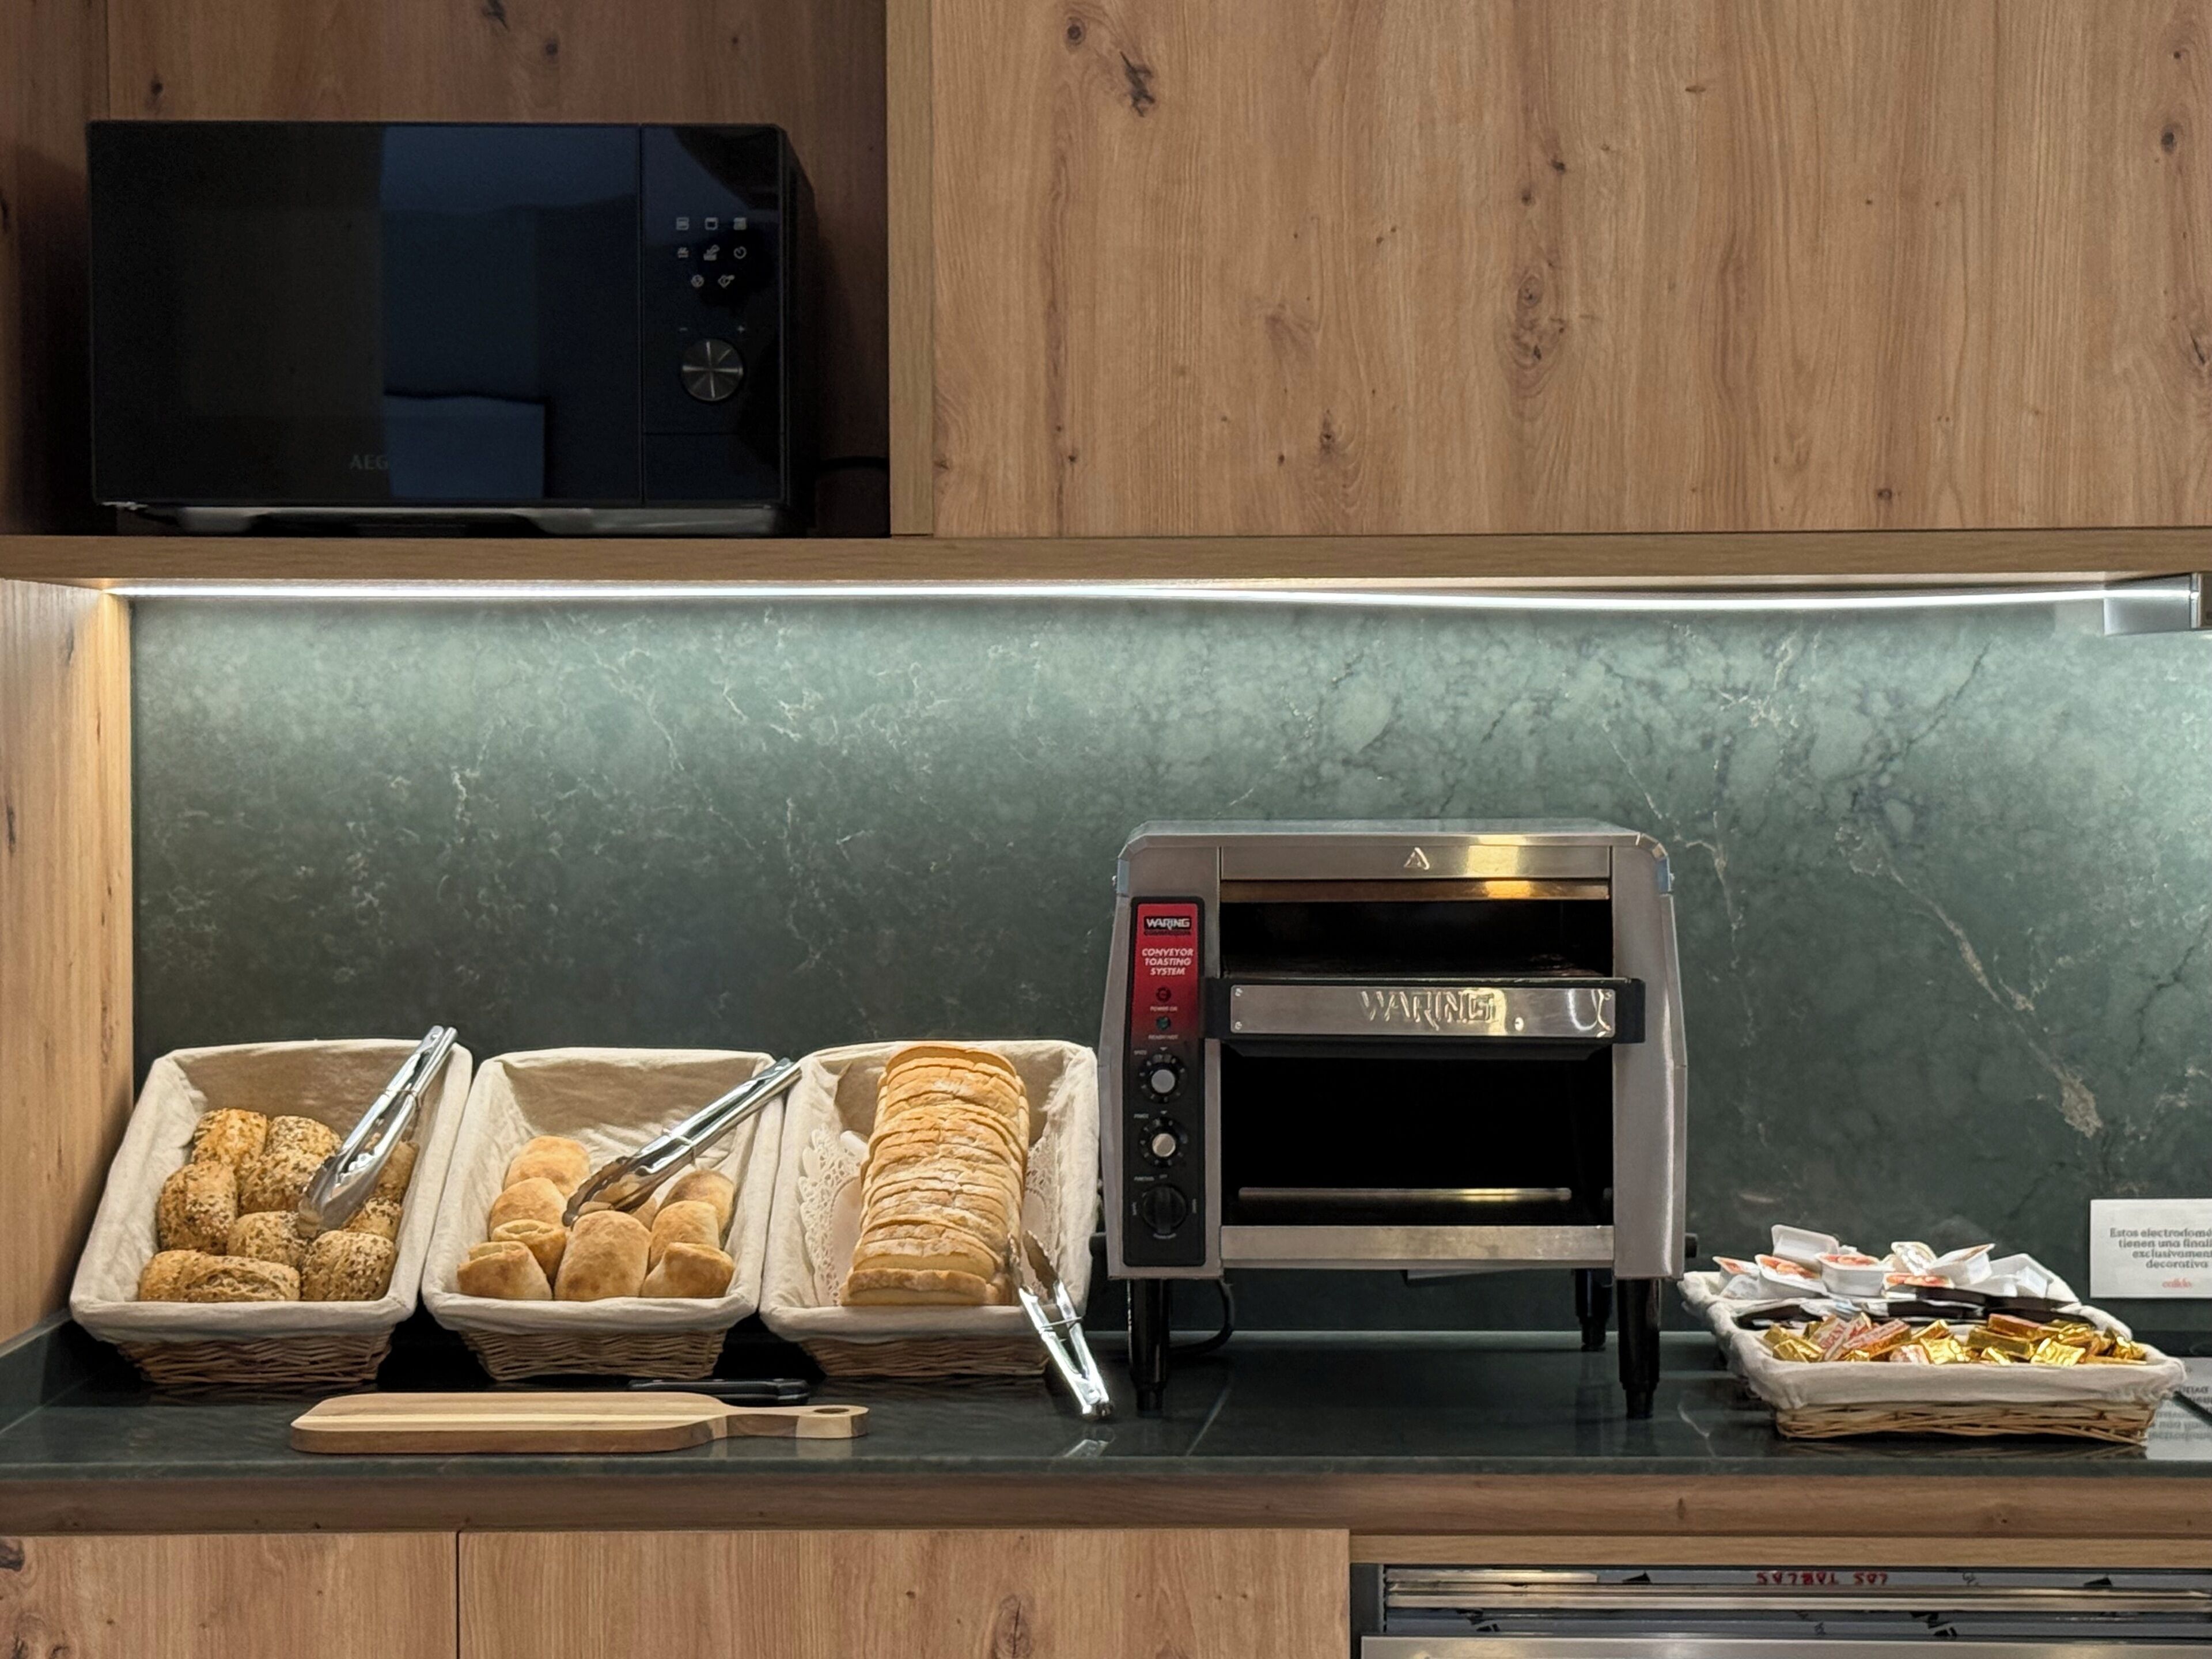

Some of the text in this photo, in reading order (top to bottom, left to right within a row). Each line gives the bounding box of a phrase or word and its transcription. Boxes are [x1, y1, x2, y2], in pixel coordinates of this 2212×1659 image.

[349, 454, 389, 470] AEG
[1146, 918, 1190, 930] WARING
[1142, 948, 1194, 956] CONVEYOR
[1145, 958, 1191, 966] TOASTING
[1150, 968, 1185, 976] SYSTEM
[1359, 990, 1495, 1031] WARING
[2110, 1228, 2138, 1238] Estos
[2119, 1238, 2155, 1248] tienen
[2146, 1259, 2209, 1268] decorativa
